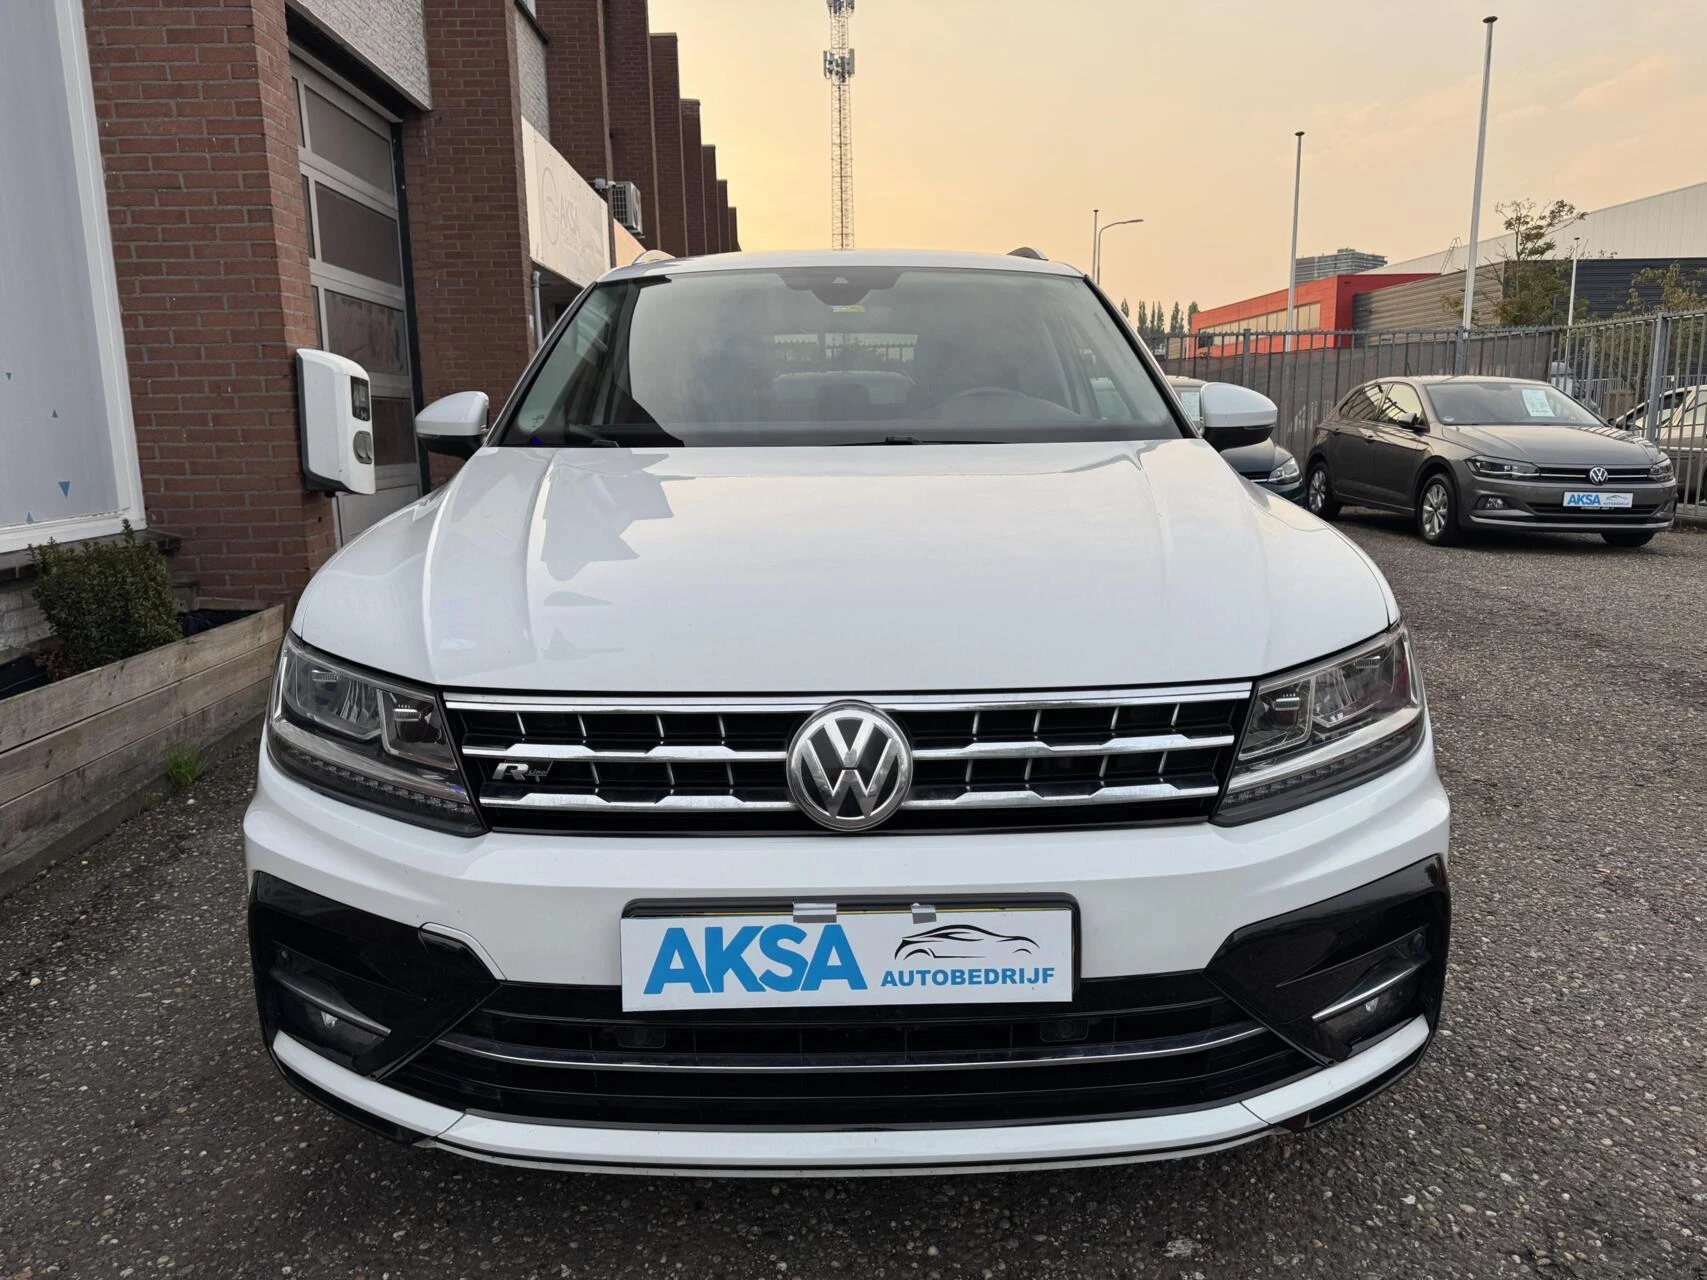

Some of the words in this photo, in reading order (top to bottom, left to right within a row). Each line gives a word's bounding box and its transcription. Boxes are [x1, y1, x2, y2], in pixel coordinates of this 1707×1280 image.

[1567, 494, 1601, 506] AKSA
[643, 924, 868, 995] AKSA
[880, 967, 1055, 988] AUTOBEDRIJF
